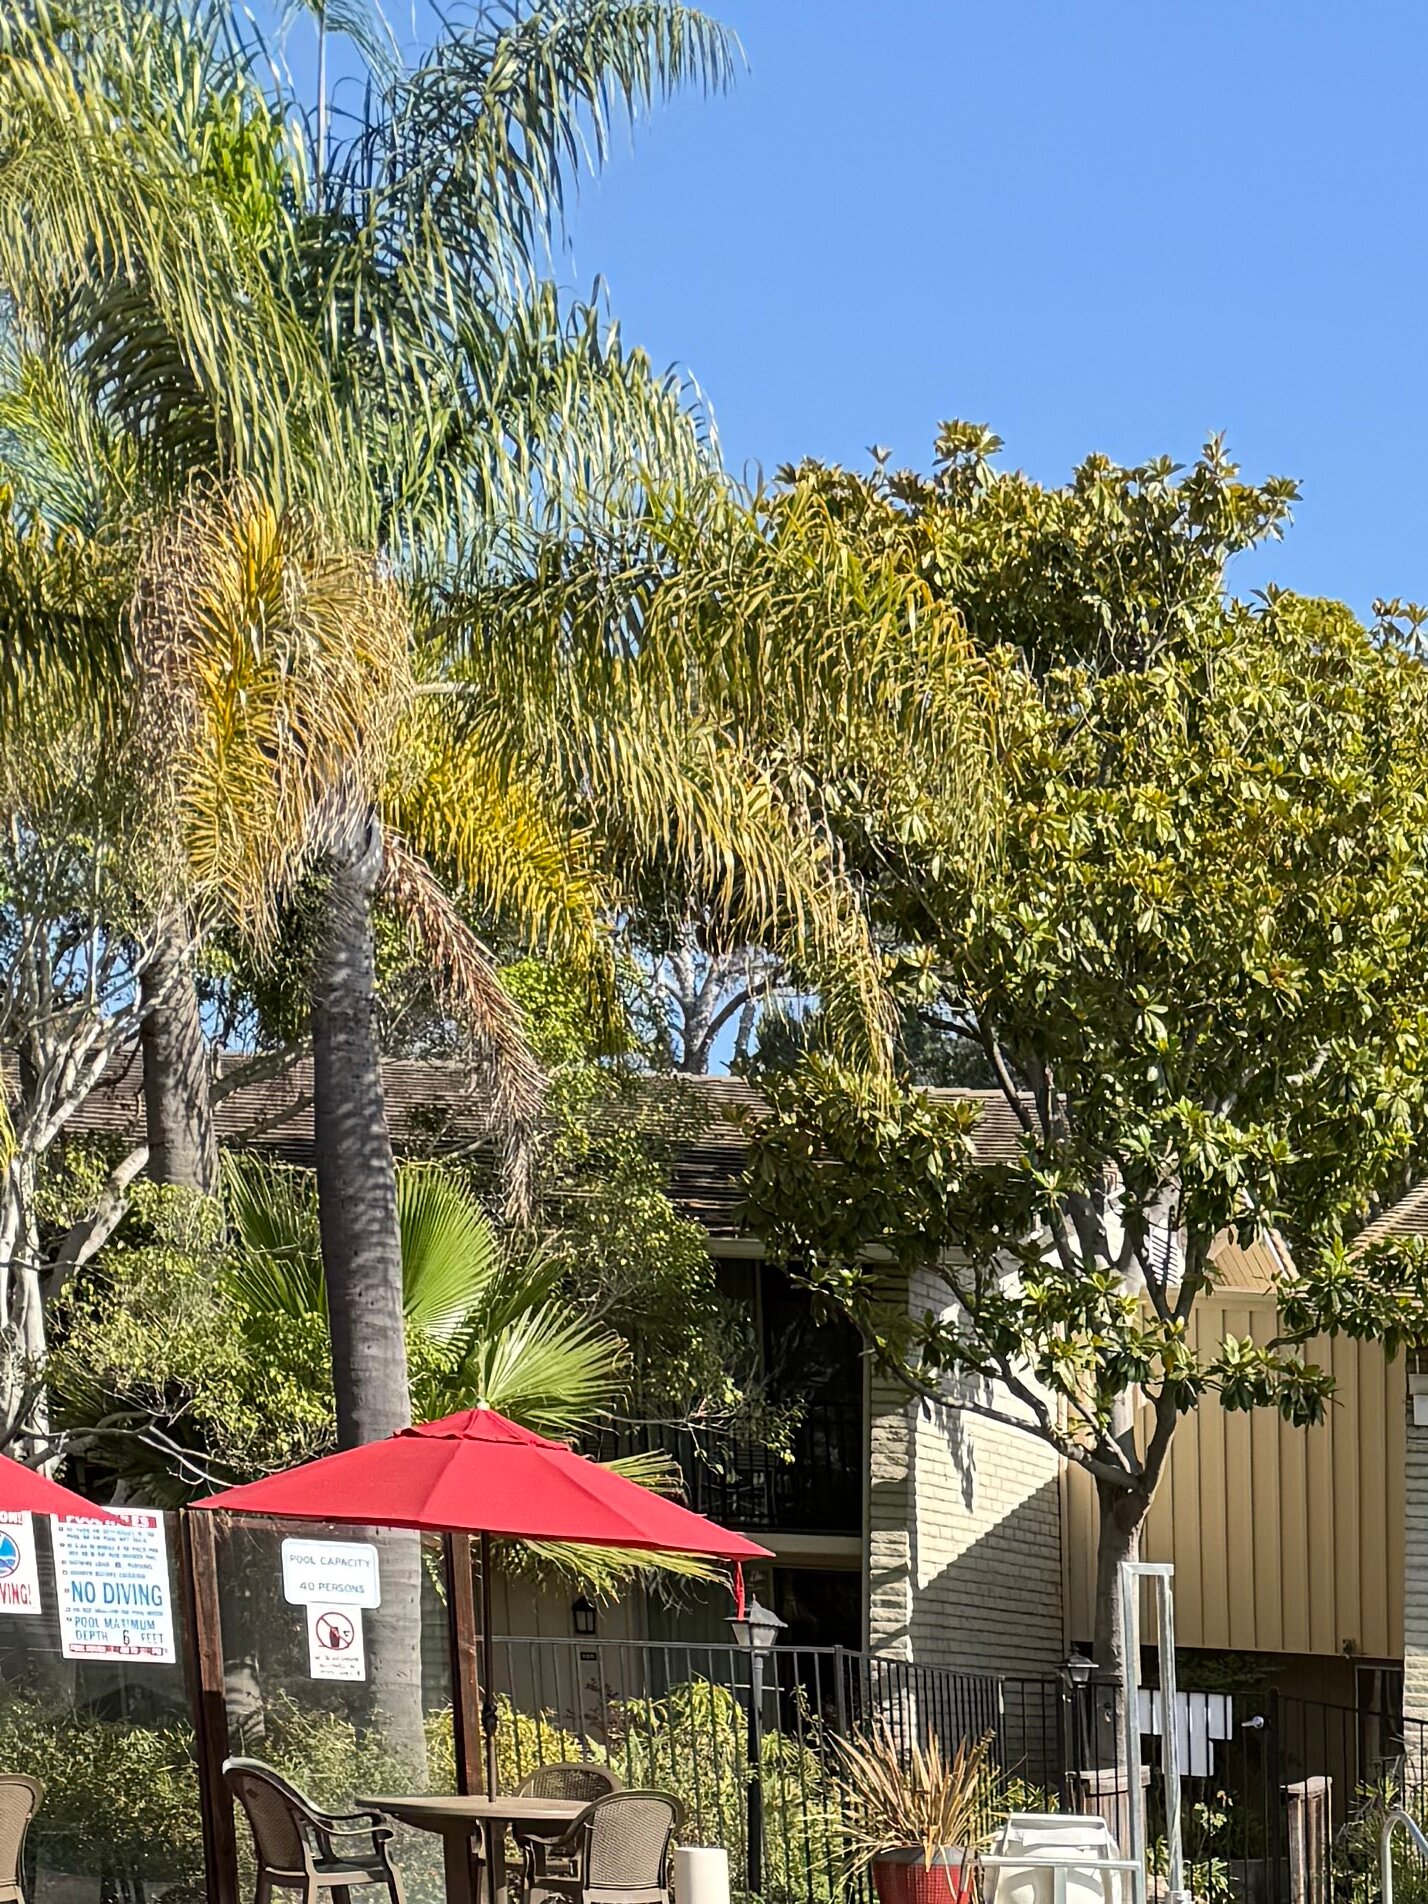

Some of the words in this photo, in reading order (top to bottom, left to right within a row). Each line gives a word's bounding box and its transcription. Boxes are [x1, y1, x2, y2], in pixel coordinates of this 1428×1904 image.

[290, 1555, 316, 1565] POOL
[320, 1557, 370, 1568] CAPACITY
[71, 1580, 96, 1604] NO
[103, 1582, 163, 1606] DIVING
[318, 1582, 365, 1594] PERSONS
[75, 1616, 100, 1629] POOL
[122, 1629, 130, 1646] 6
